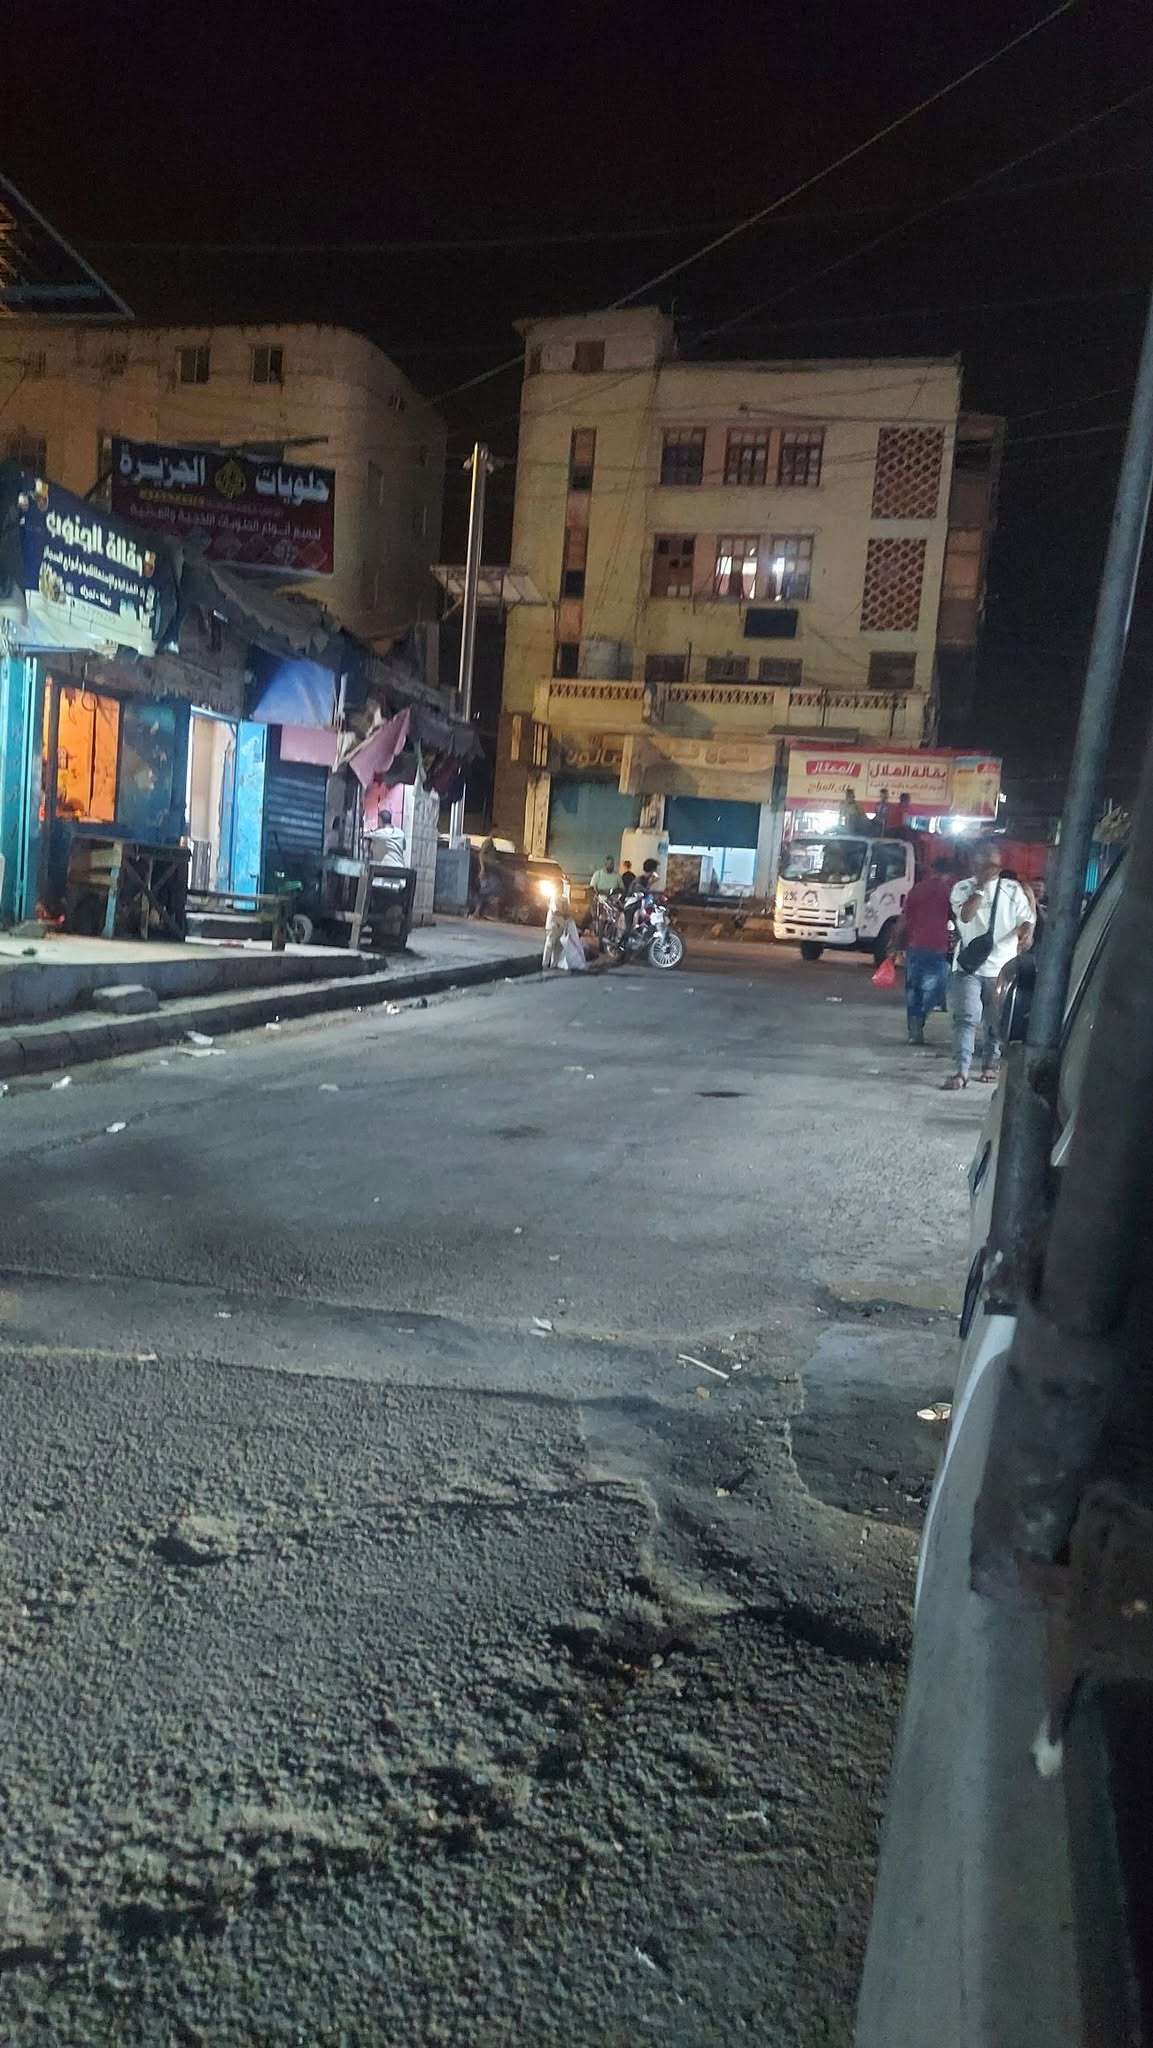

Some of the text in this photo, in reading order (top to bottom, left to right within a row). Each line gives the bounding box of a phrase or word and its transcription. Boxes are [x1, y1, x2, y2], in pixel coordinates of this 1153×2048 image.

[119, 443, 206, 489] الجزيرة
[46, 511, 103, 555] الجنوب
[106, 532, 142, 577] بقالة
[869, 761, 946, 782] بقالة الهلال
